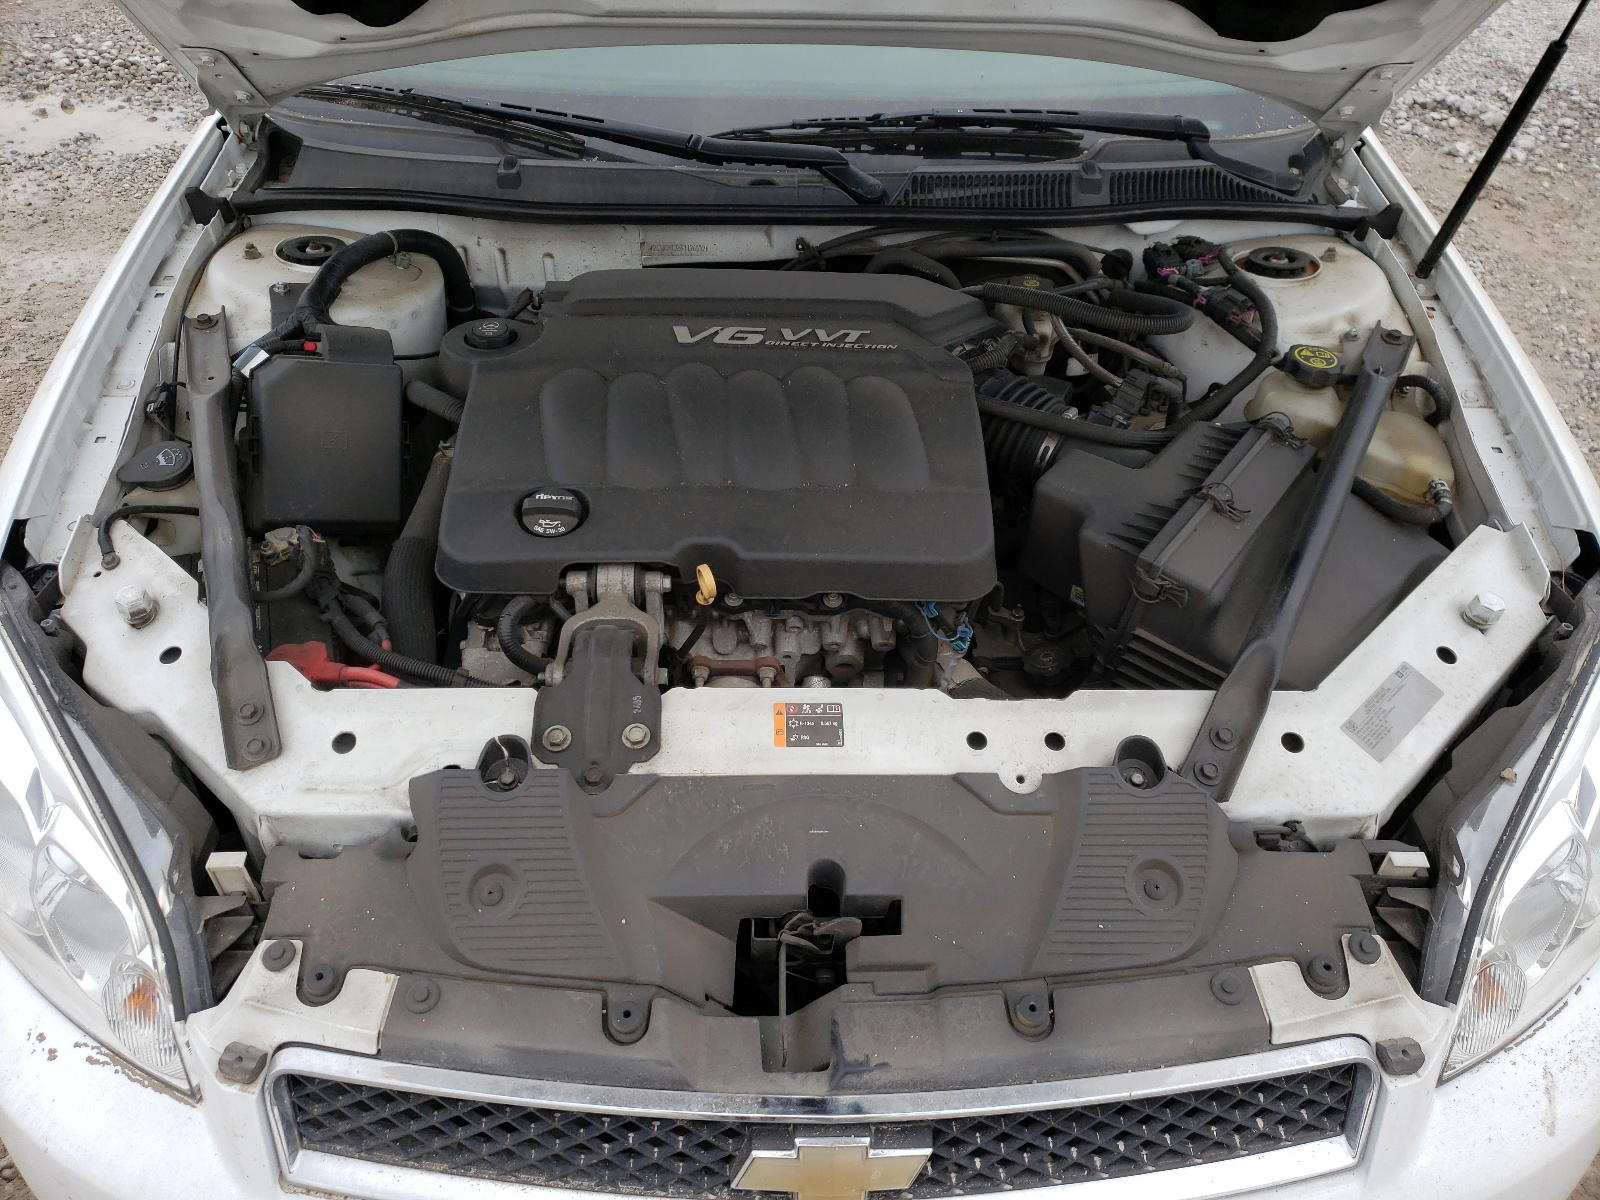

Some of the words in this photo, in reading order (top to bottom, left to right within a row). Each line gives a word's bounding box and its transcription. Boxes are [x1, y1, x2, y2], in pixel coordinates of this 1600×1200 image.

[672, 325, 766, 345] V6
[780, 327, 871, 343] VVT
[822, 342, 898, 350] INJECTION
